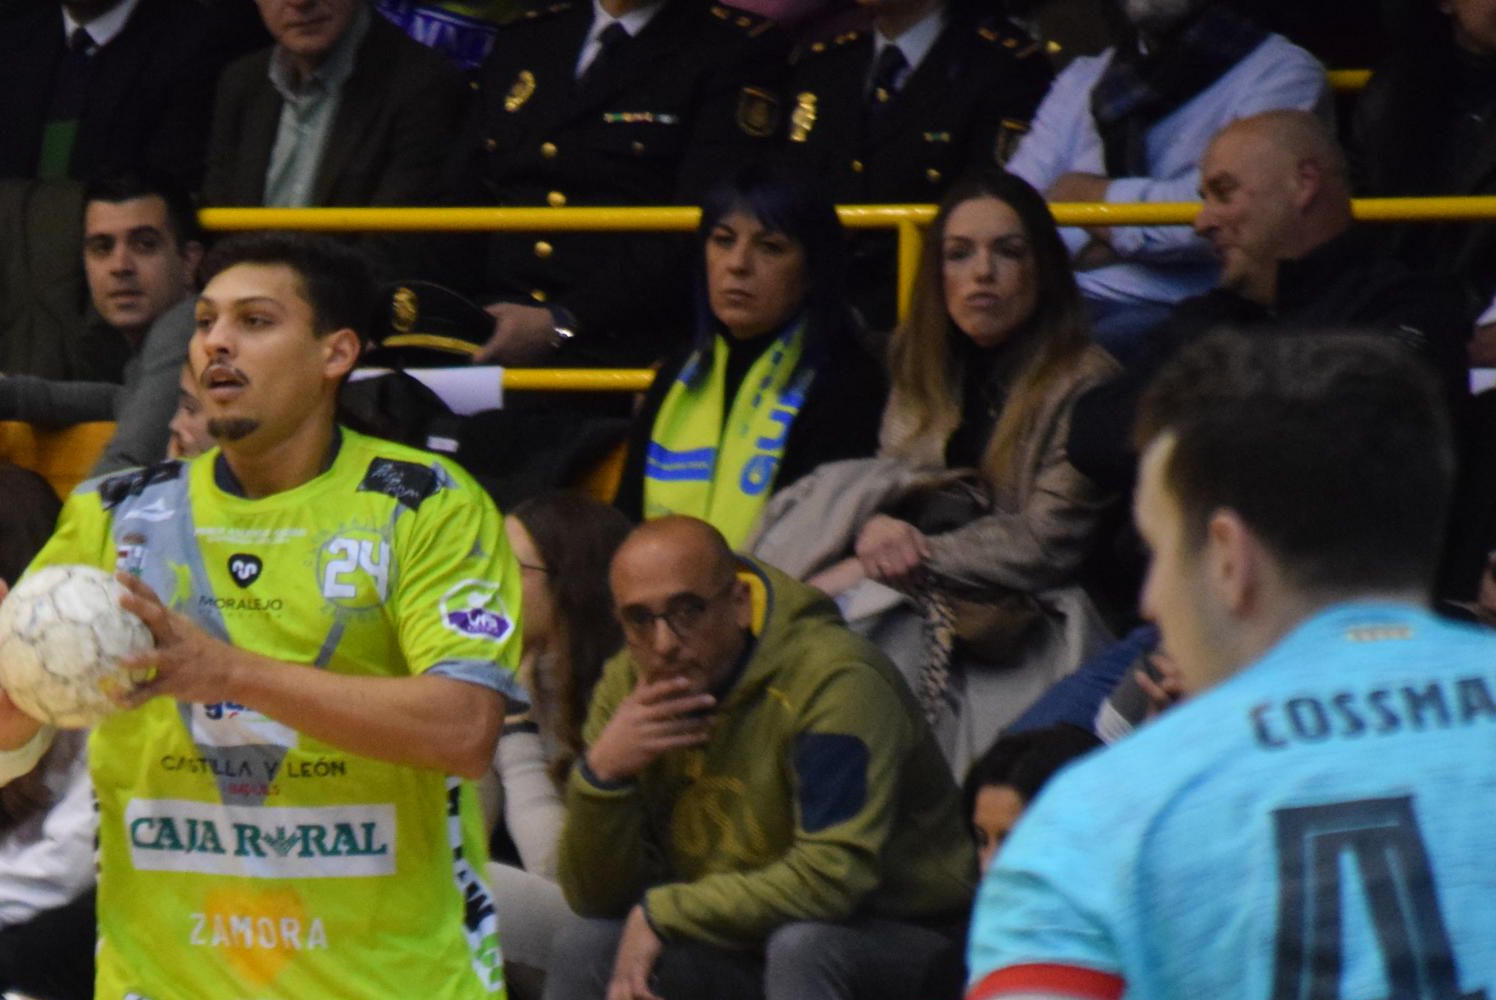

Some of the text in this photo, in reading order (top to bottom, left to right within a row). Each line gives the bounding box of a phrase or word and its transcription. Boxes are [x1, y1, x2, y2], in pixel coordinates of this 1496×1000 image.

[323, 537, 391, 601] 24
[198, 595, 283, 610] MORALEJO
[161, 755, 347, 781] CASTILLA Y LEÓN
[129, 816, 226, 854] CAJA
[189, 913, 328, 952] ZAMORA
